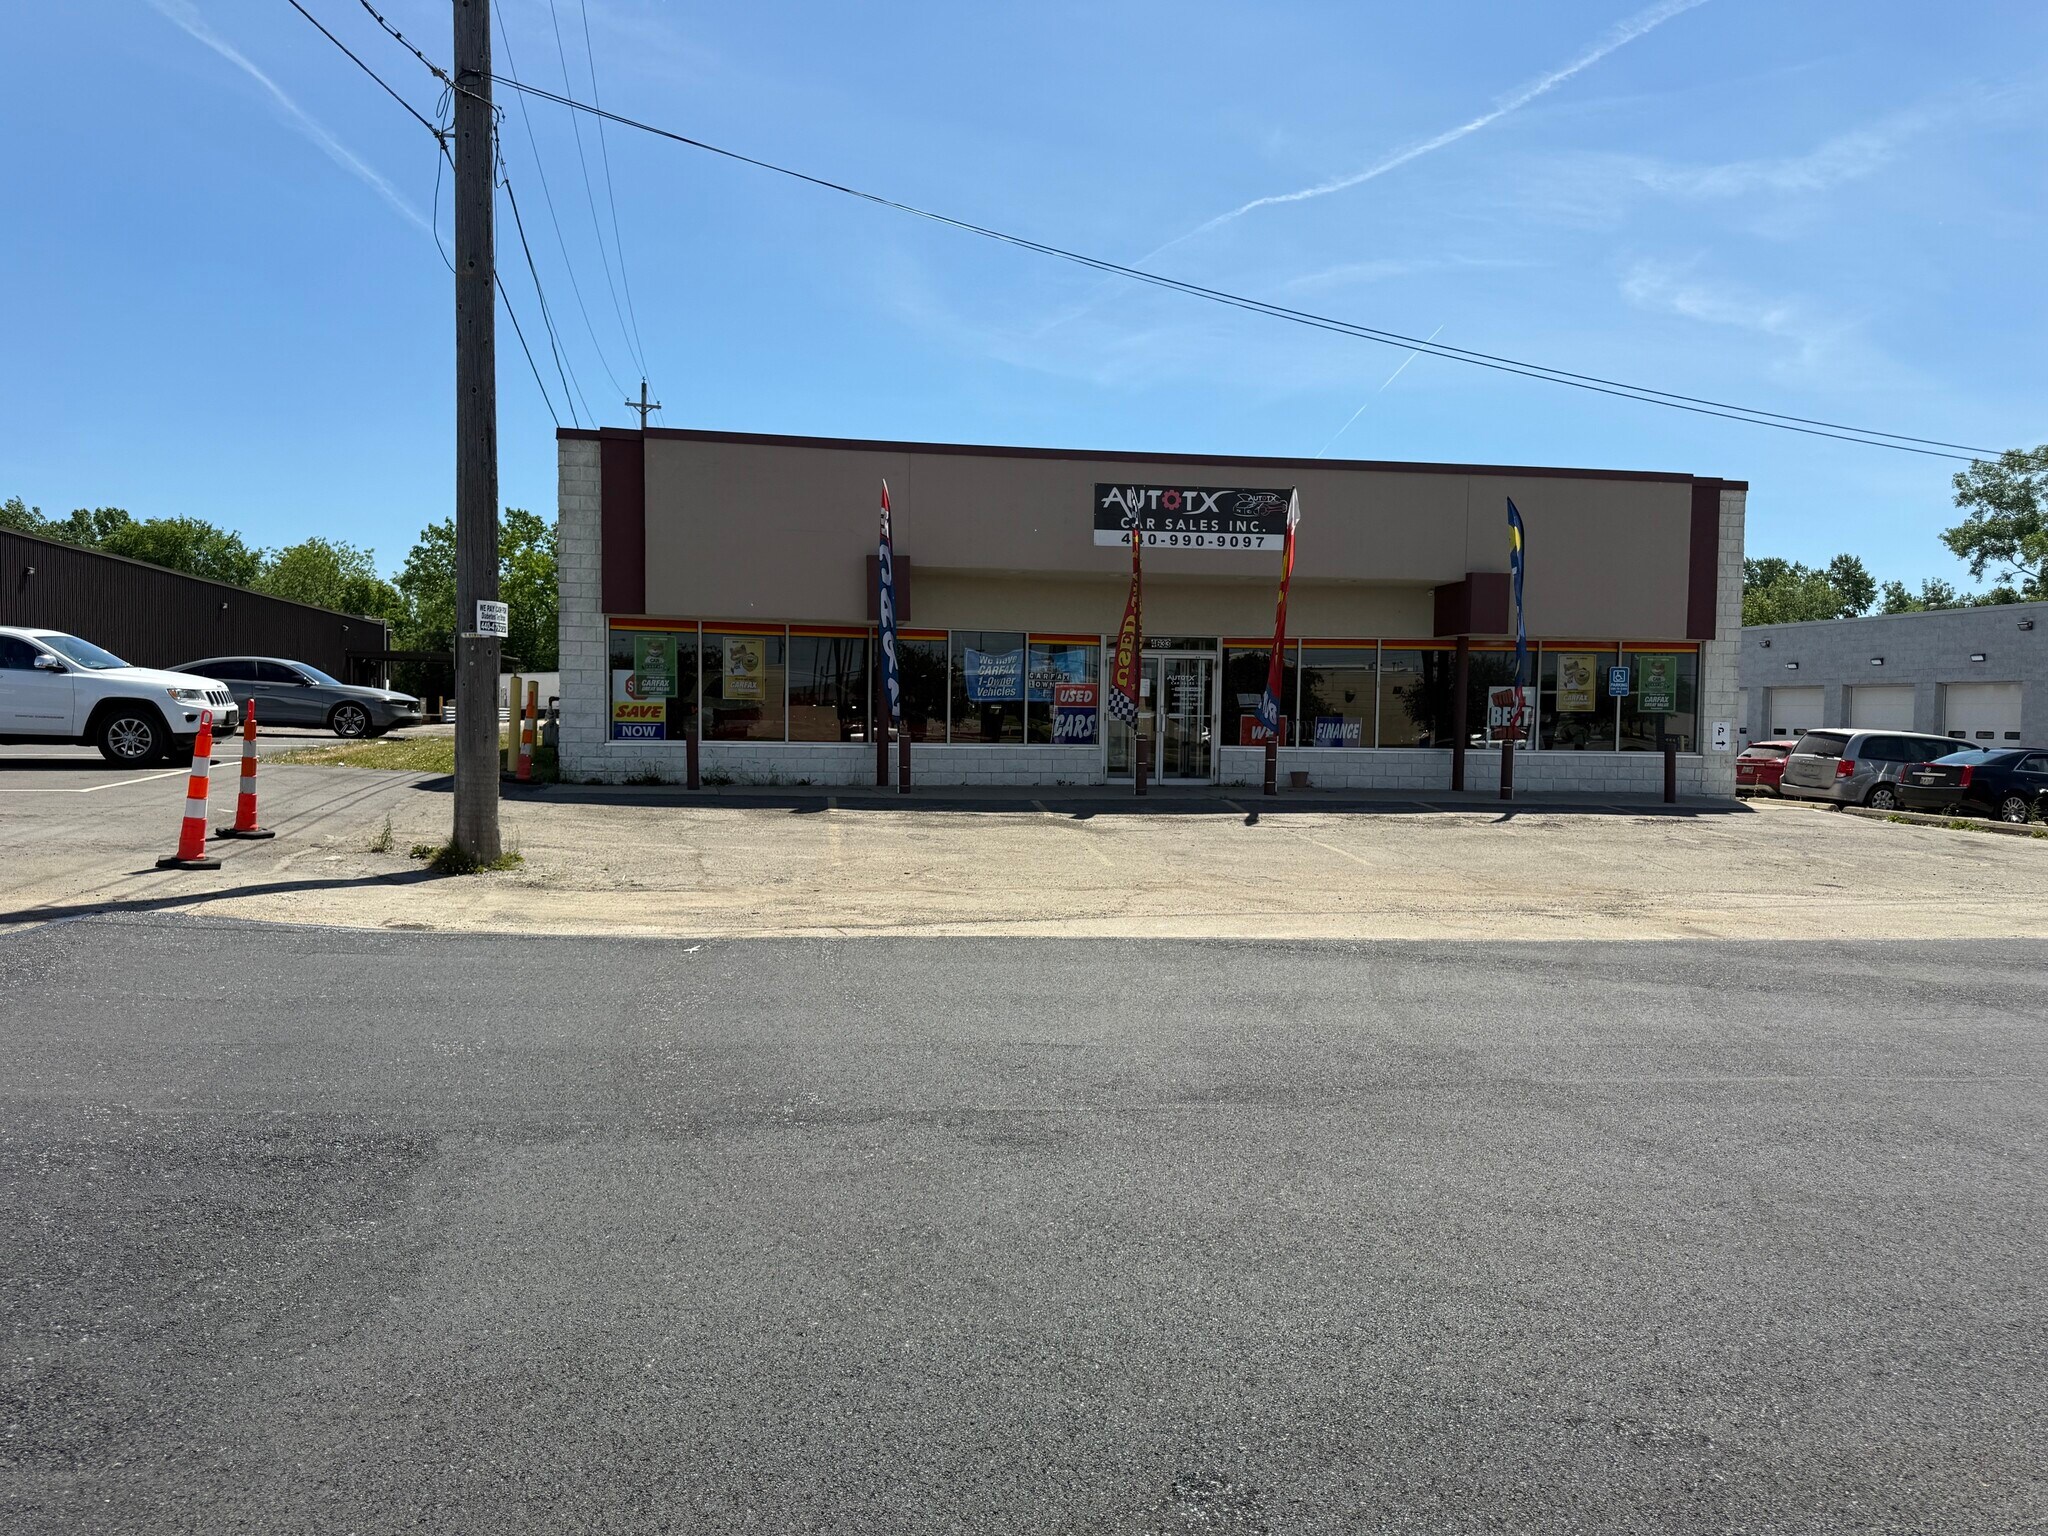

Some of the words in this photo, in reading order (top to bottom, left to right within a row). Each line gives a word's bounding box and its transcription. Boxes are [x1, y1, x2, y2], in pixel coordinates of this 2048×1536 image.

[1101, 486, 1236, 518] AUTOTX
[1165, 519, 1219, 531] SALES
[1229, 521, 1266, 532] INC.
[978, 664, 1016, 675] CARFAX
[978, 676, 1016, 686] 1-Owner
[1029, 672, 1070, 680] CARFAX
[641, 679, 670, 687] CARFAX
[730, 681, 757, 689] CARFAX
[977, 686, 1016, 697] Vehicles
[1060, 690, 1093, 703] USED
[615, 704, 663, 718] SAVE
[1491, 706, 1532, 726] BEST
[622, 726, 656, 737] NOW
[1053, 714, 1096, 738] CARS
[1316, 723, 1360, 739] FINANCE
